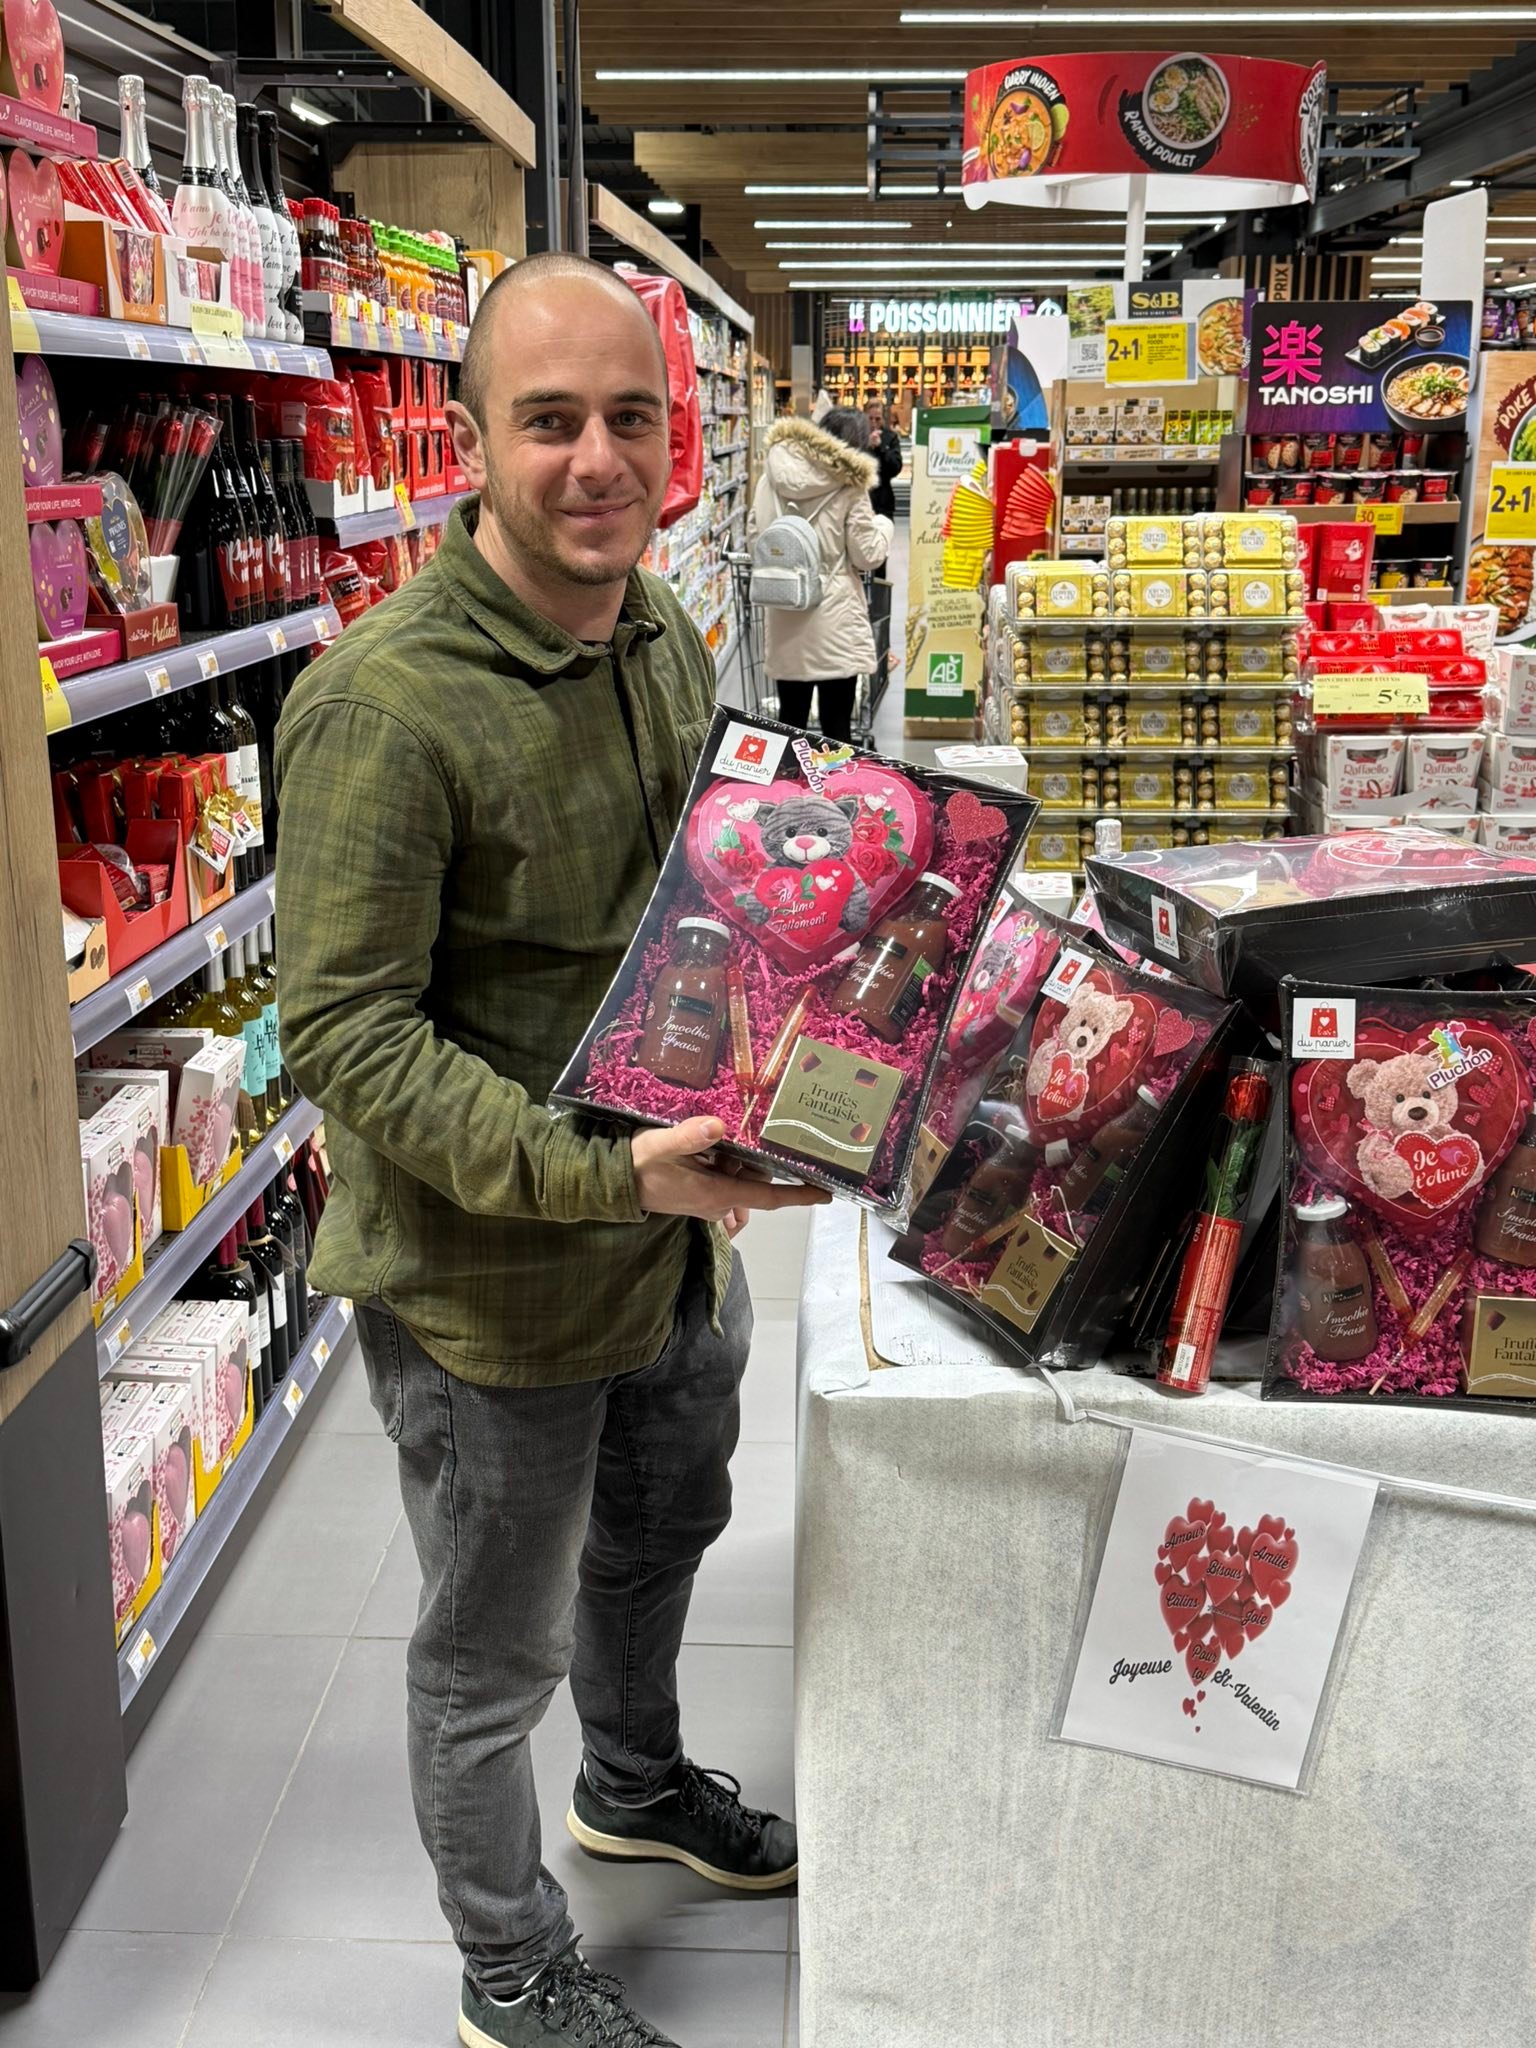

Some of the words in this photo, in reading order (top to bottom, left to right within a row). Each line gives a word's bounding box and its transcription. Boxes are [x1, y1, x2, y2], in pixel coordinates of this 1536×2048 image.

[1029, 71, 1060, 100] INDIEN
[1124, 109, 1156, 151] RAMEN
[1153, 145, 1196, 168] POULET
[1275, 267, 1289, 300] PRIX
[1132, 292, 1180, 309] S&B
[849, 319, 865, 332] LA
[1108, 338, 1139, 361] 2+1
[1261, 320, 1323, 385] 楽
[1258, 385, 1374, 405] TANOSHI
[1499, 391, 1532, 430] POKE
[930, 451, 975, 468] Moulin
[1492, 485, 1532, 514] 2+1
[930, 662, 958, 682] AB
[720, 754, 734, 767] du
[736, 761, 771, 776] panier
[794, 740, 824, 792] Pluchon
[1343, 763, 1389, 775] Raffaello
[1423, 763, 1468, 775] Raffaello
[656, 1015, 711, 1041] Smoothie
[661, 1031, 702, 1054] Fraise
[1297, 1033, 1313, 1047] du
[1315, 1039, 1351, 1049] panier
[1051, 1068, 1067, 1086] Je
[1430, 1050, 1490, 1087] Pluchon
[811, 1082, 859, 1110] Truffes
[798, 1092, 861, 1124] Fantaisie
[1413, 1147, 1439, 1171] Je
[1006, 1262, 1037, 1290] Fantaisie
[1016, 1256, 1039, 1278] Truffes
[1320, 1305, 1369, 1324] Smoothie
[1328, 1323, 1366, 1338] Fraise
[1494, 1348, 1536, 1361] Fantai
[1164, 1525, 1206, 1548] Amour
[1206, 1558, 1245, 1579] Bisous
[1252, 1546, 1291, 1570] Amitié
[1165, 1592, 1200, 1609] Câlins
[1241, 1610, 1268, 1627] Joie
[1191, 1644, 1218, 1664] Pour
[1109, 1658, 1173, 1685] Joyeuse
[1191, 1666, 1208, 1682] toi
[1210, 1667, 1280, 1732] St-Valentin
